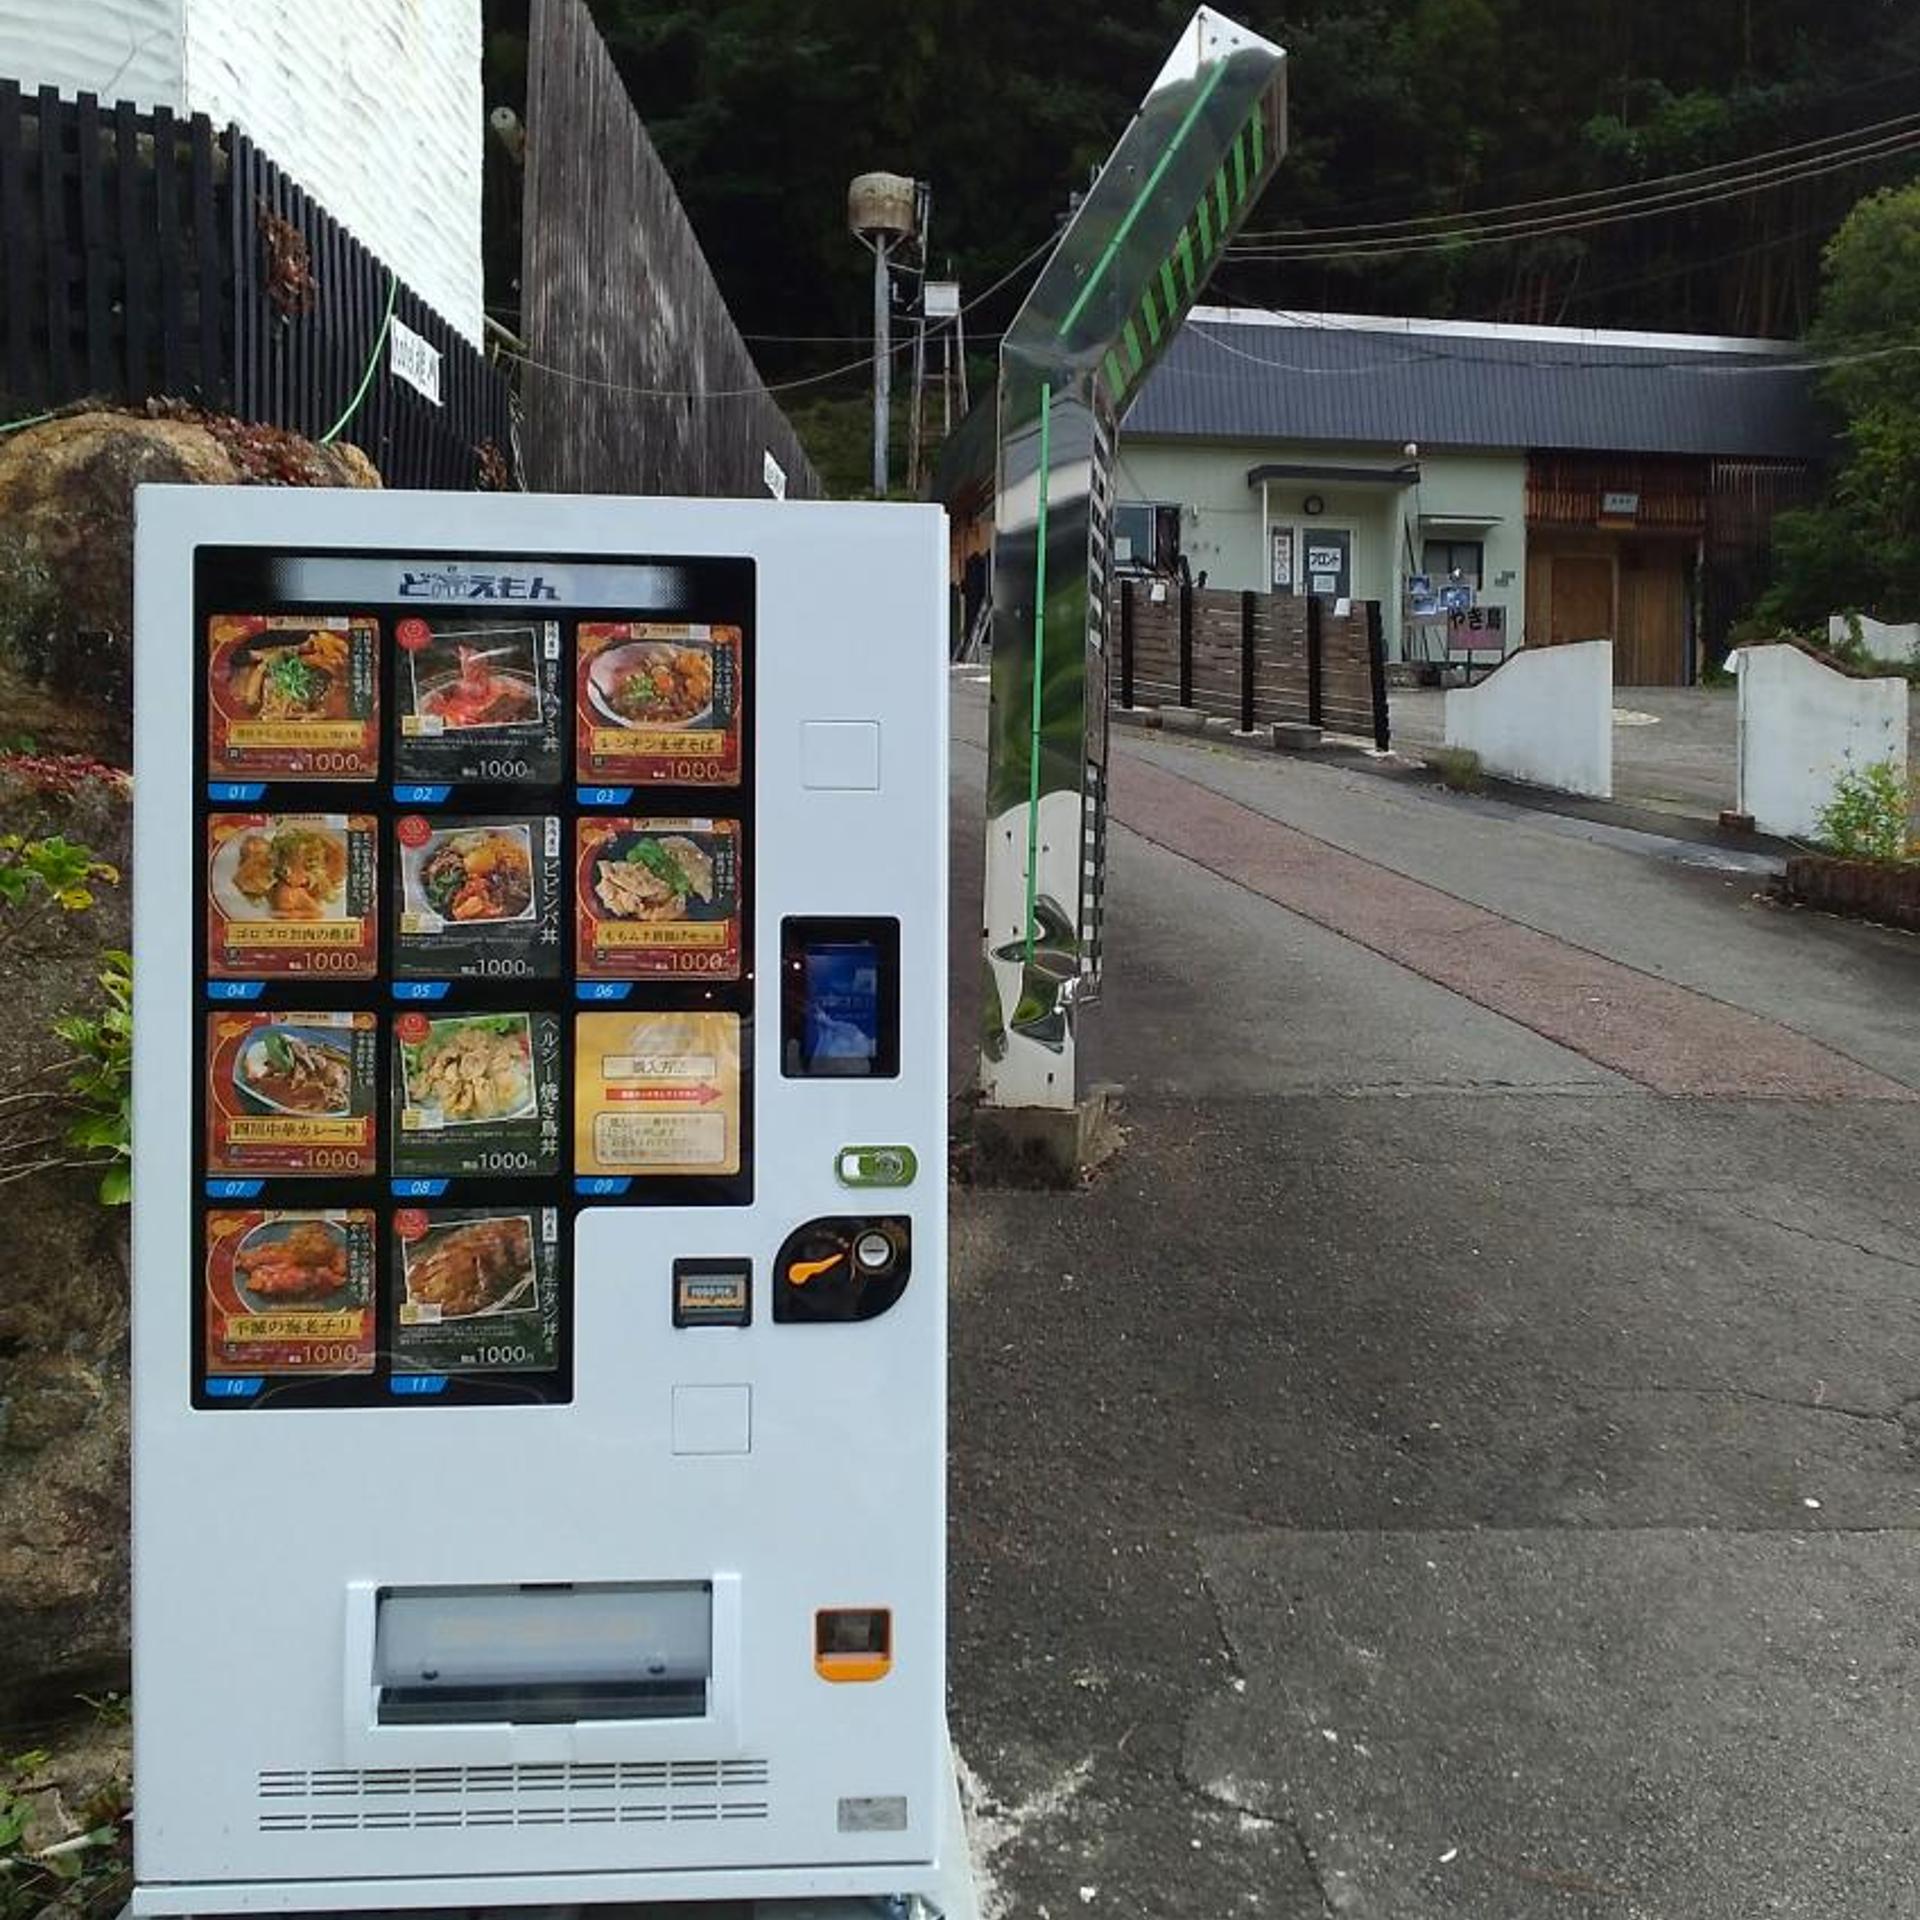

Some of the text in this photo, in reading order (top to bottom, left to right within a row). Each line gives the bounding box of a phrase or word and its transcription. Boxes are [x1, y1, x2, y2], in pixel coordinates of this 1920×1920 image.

[228, 787, 247, 800] 01
[412, 787, 433, 801] 02
[596, 790, 615, 803] 03
[227, 984, 246, 997] 04
[411, 984, 431, 997] 05
[596, 984, 614, 998] 06
[225, 1181, 244, 1195] 07
[410, 1181, 430, 1195] 08
[594, 1180, 614, 1194] 09
[226, 1380, 244, 1394] 10
[412, 1378, 429, 1391] 11
